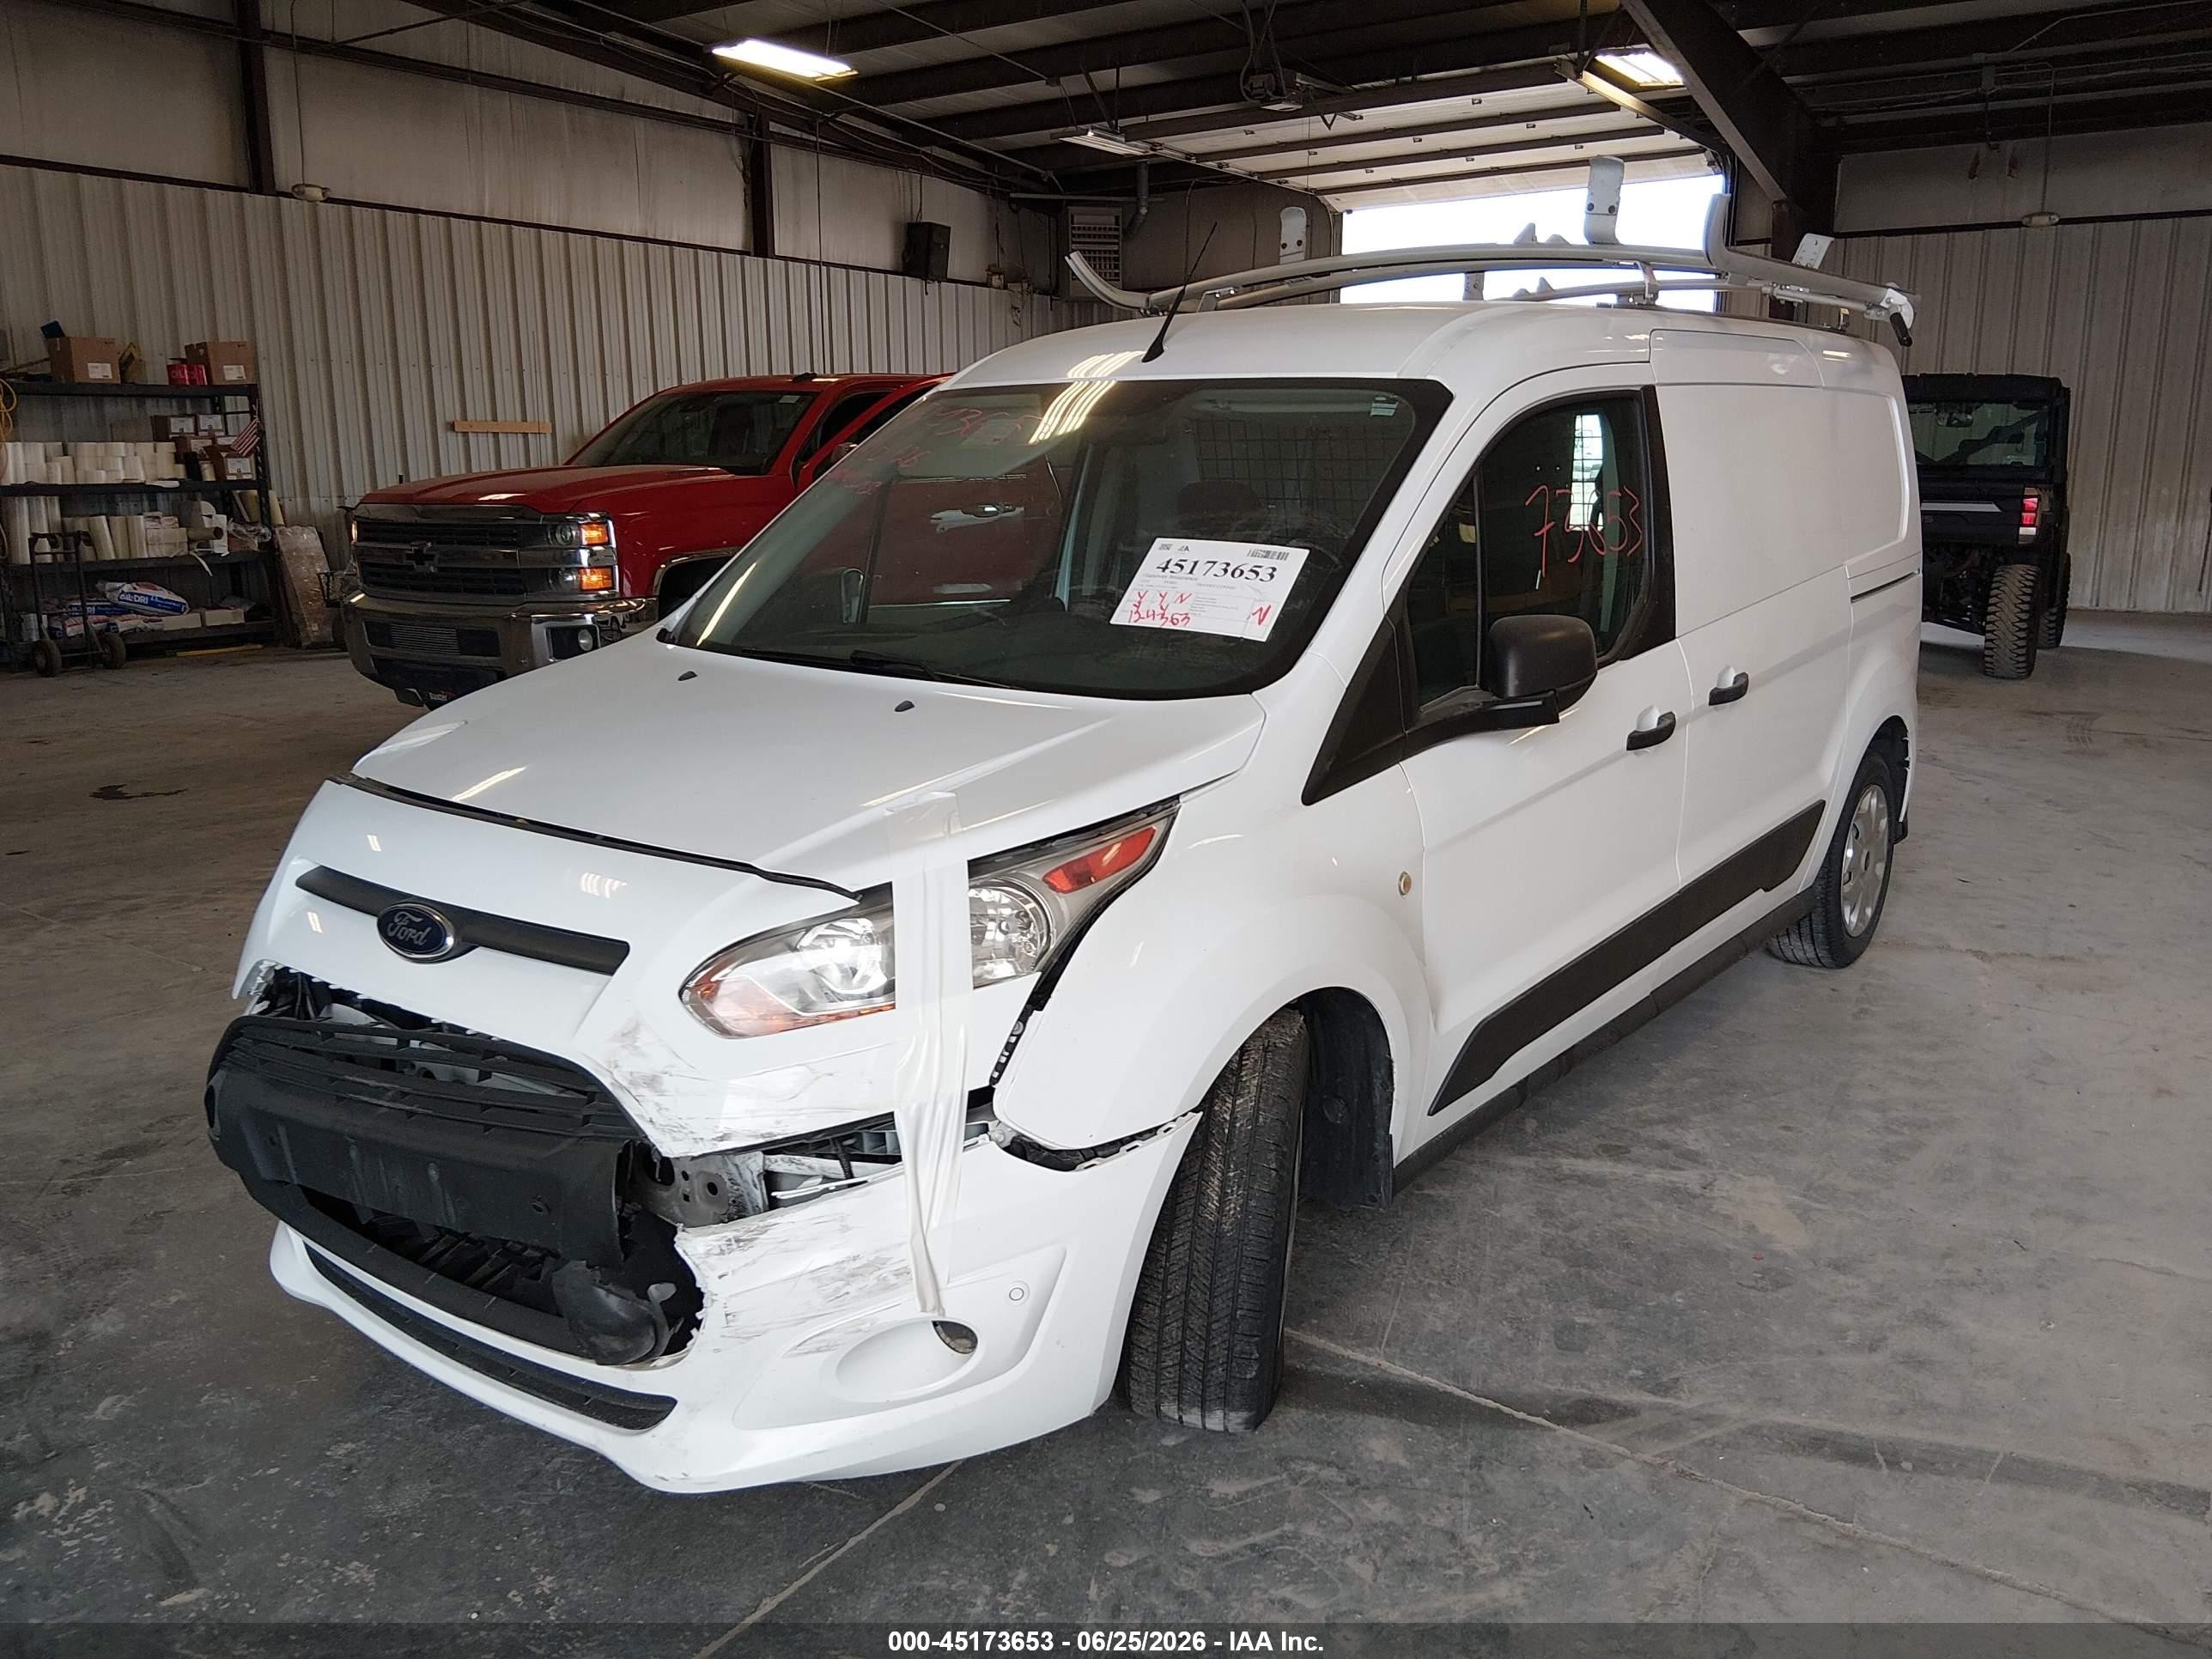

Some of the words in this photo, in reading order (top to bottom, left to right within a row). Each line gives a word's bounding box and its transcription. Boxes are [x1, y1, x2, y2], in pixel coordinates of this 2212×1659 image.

[1156, 557, 1278, 583] 45173653
[1252, 604, 1272, 626] N
[387, 910, 432, 946] Ford
